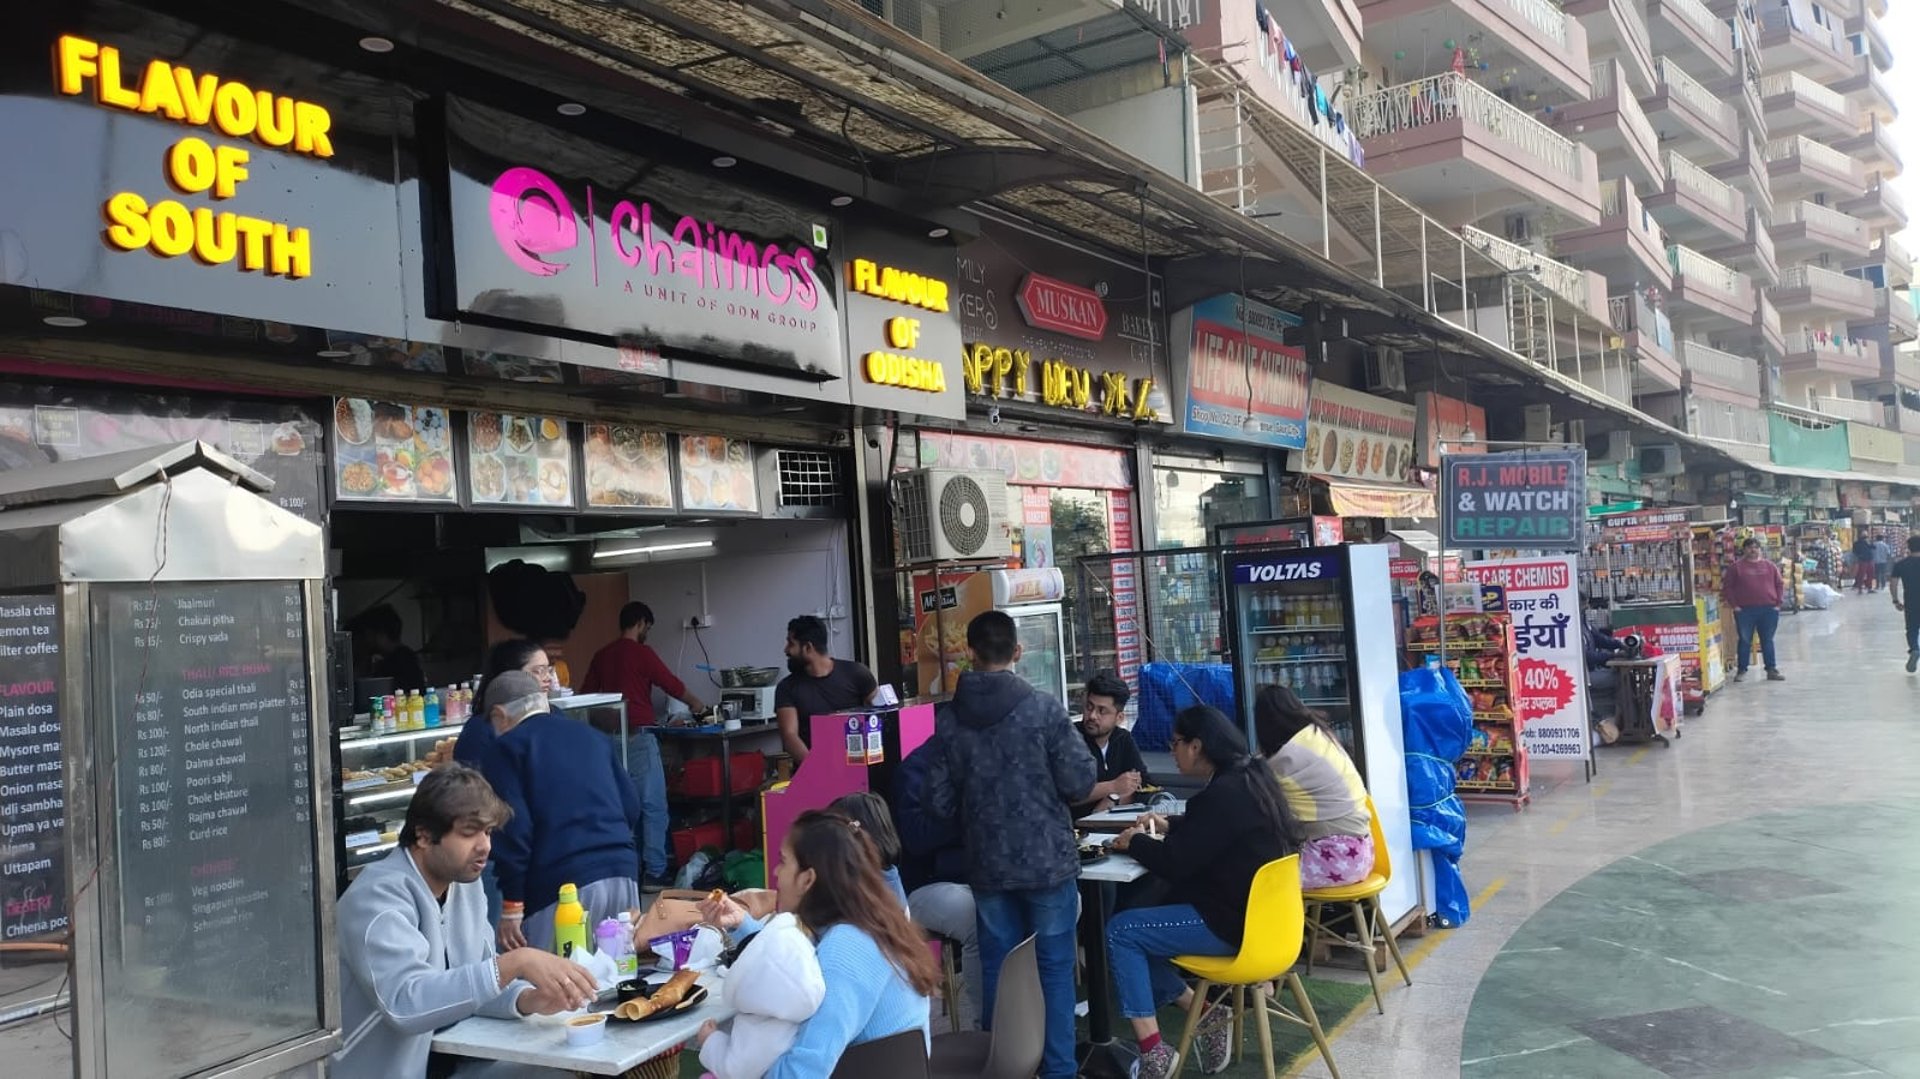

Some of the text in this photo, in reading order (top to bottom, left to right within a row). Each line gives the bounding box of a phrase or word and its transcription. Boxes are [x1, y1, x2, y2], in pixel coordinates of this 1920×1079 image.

[58, 35, 334, 157] FLAVOUR
[170, 136, 249, 198] OF
[106, 191, 311, 277] SOUTH
[852, 256, 950, 313] FLAVOUR
[623, 280, 633, 294] A
[644, 284, 688, 304] UNIT
[696, 297, 718, 311] OF
[767, 312, 816, 333] GROUP
[1035, 286, 1098, 327] MUSKAN
[888, 316, 920, 349] OF
[865, 351, 946, 393] ODISHA
[1193, 329, 1224, 394] LIFE
[1259, 352, 1308, 411] CHEMIST
[1458, 464, 1568, 486] R.J. MOBILE
[1458, 491, 1476, 511] &
[1484, 490, 1569, 511] WATCH
[1456, 515, 1570, 537] REPAIR
[1607, 513, 1685, 527] GUPTA MOMOS
[1250, 562, 1322, 582] VOLTAS
[1483, 568, 1512, 587] CARE
[1515, 565, 1567, 588] CHEMIST
[1539, 593, 1559, 610] की
[33, 604, 55, 616] chai
[213, 614, 235, 627] pitha
[32, 624, 49, 636] tea
[179, 631, 228, 646] Crispy vada
[1660, 633, 1699, 645] MOMOS
[24, 642, 59, 655] coffee
[1525, 667, 1559, 690] 40%
[182, 684, 256, 700] Odia special thali
[27, 703, 53, 716] dosa
[136, 711, 146, 722] Rs
[183, 705, 209, 718] South
[0, 723, 37, 737] Masala
[137, 729, 147, 741] Rs
[184, 723, 210, 735] North
[0, 744, 40, 759] Mysore
[185, 736, 242, 752] Chole chawal
[138, 747, 148, 758] Rs
[186, 752, 246, 771] Dalma chawal
[0, 764, 34, 777] Butter
[139, 766, 149, 777] Rs
[187, 771, 233, 788] Poori sabji
[0, 783, 34, 797] Onion
[139, 784, 149, 795] Rs
[188, 787, 248, 806] Chole bhature
[1, 797, 64, 816] Idli sambha
[140, 802, 150, 814] Rs
[189, 804, 247, 825] Rajma chawal
[2, 822, 35, 837] Upma
[37, 819, 50, 833] ya
[141, 821, 150, 832] Rs
[189, 825, 228, 841] Curd rice
[142, 839, 152, 850] Rs
[4, 858, 52, 876] Uttapam
[6, 920, 48, 938] Chhena
